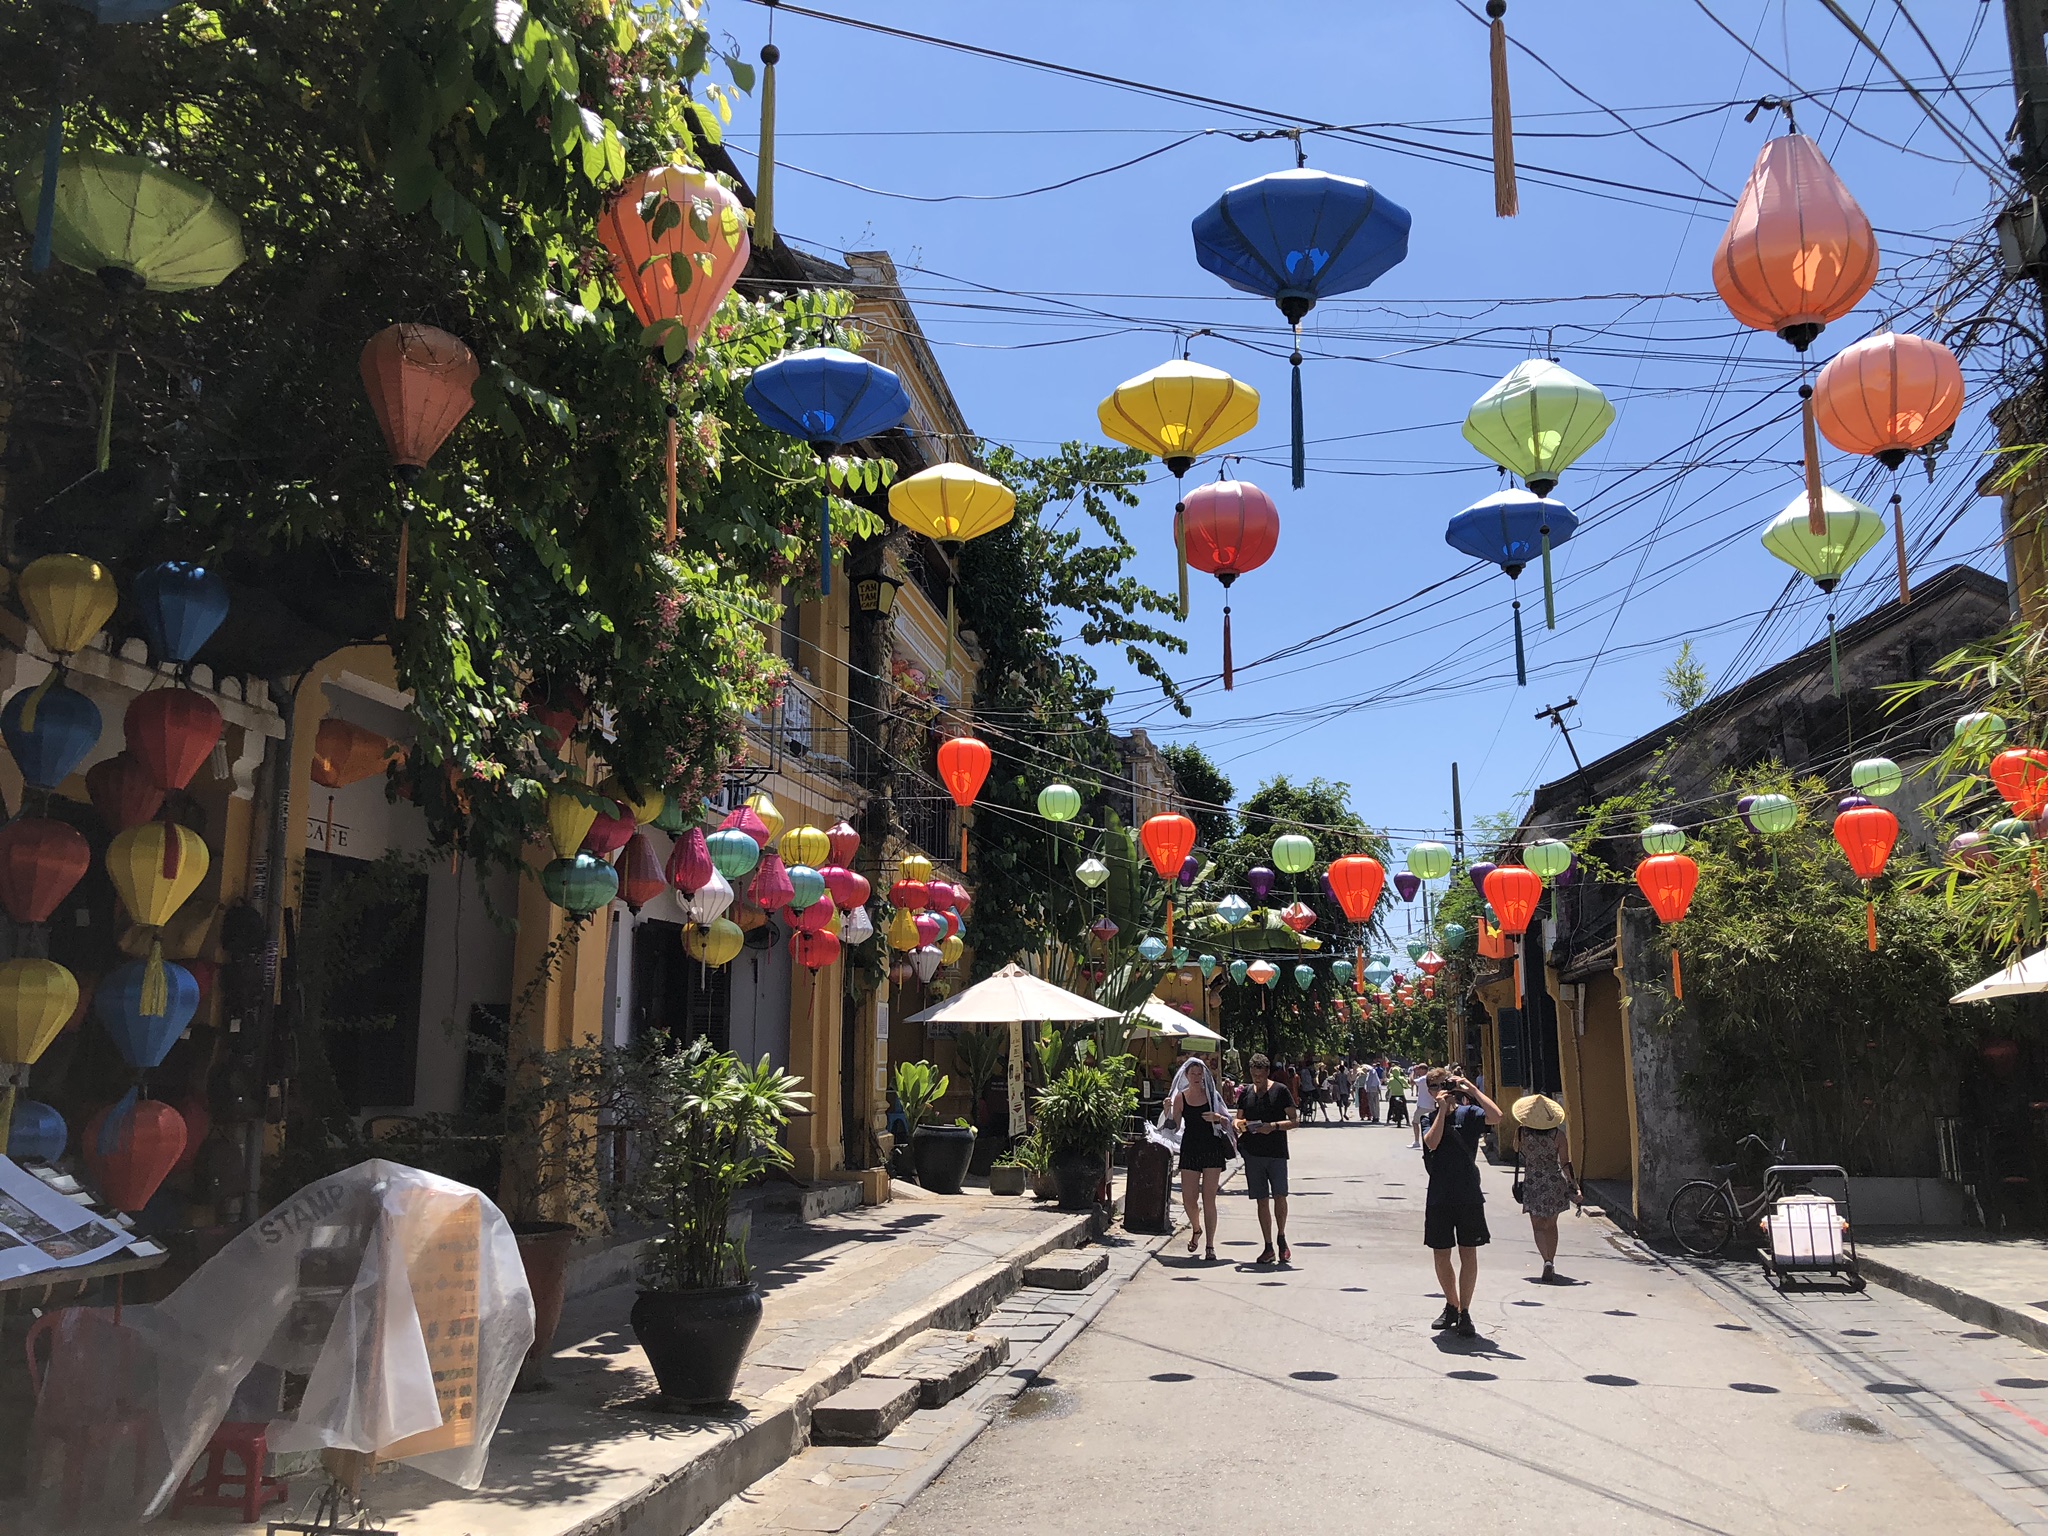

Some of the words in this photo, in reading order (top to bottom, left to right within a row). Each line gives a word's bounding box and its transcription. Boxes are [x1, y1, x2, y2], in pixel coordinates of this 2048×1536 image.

[859, 583, 877, 592] TAM
[860, 593, 877, 601] TAM
[260, 1185, 344, 1244] STAMP
